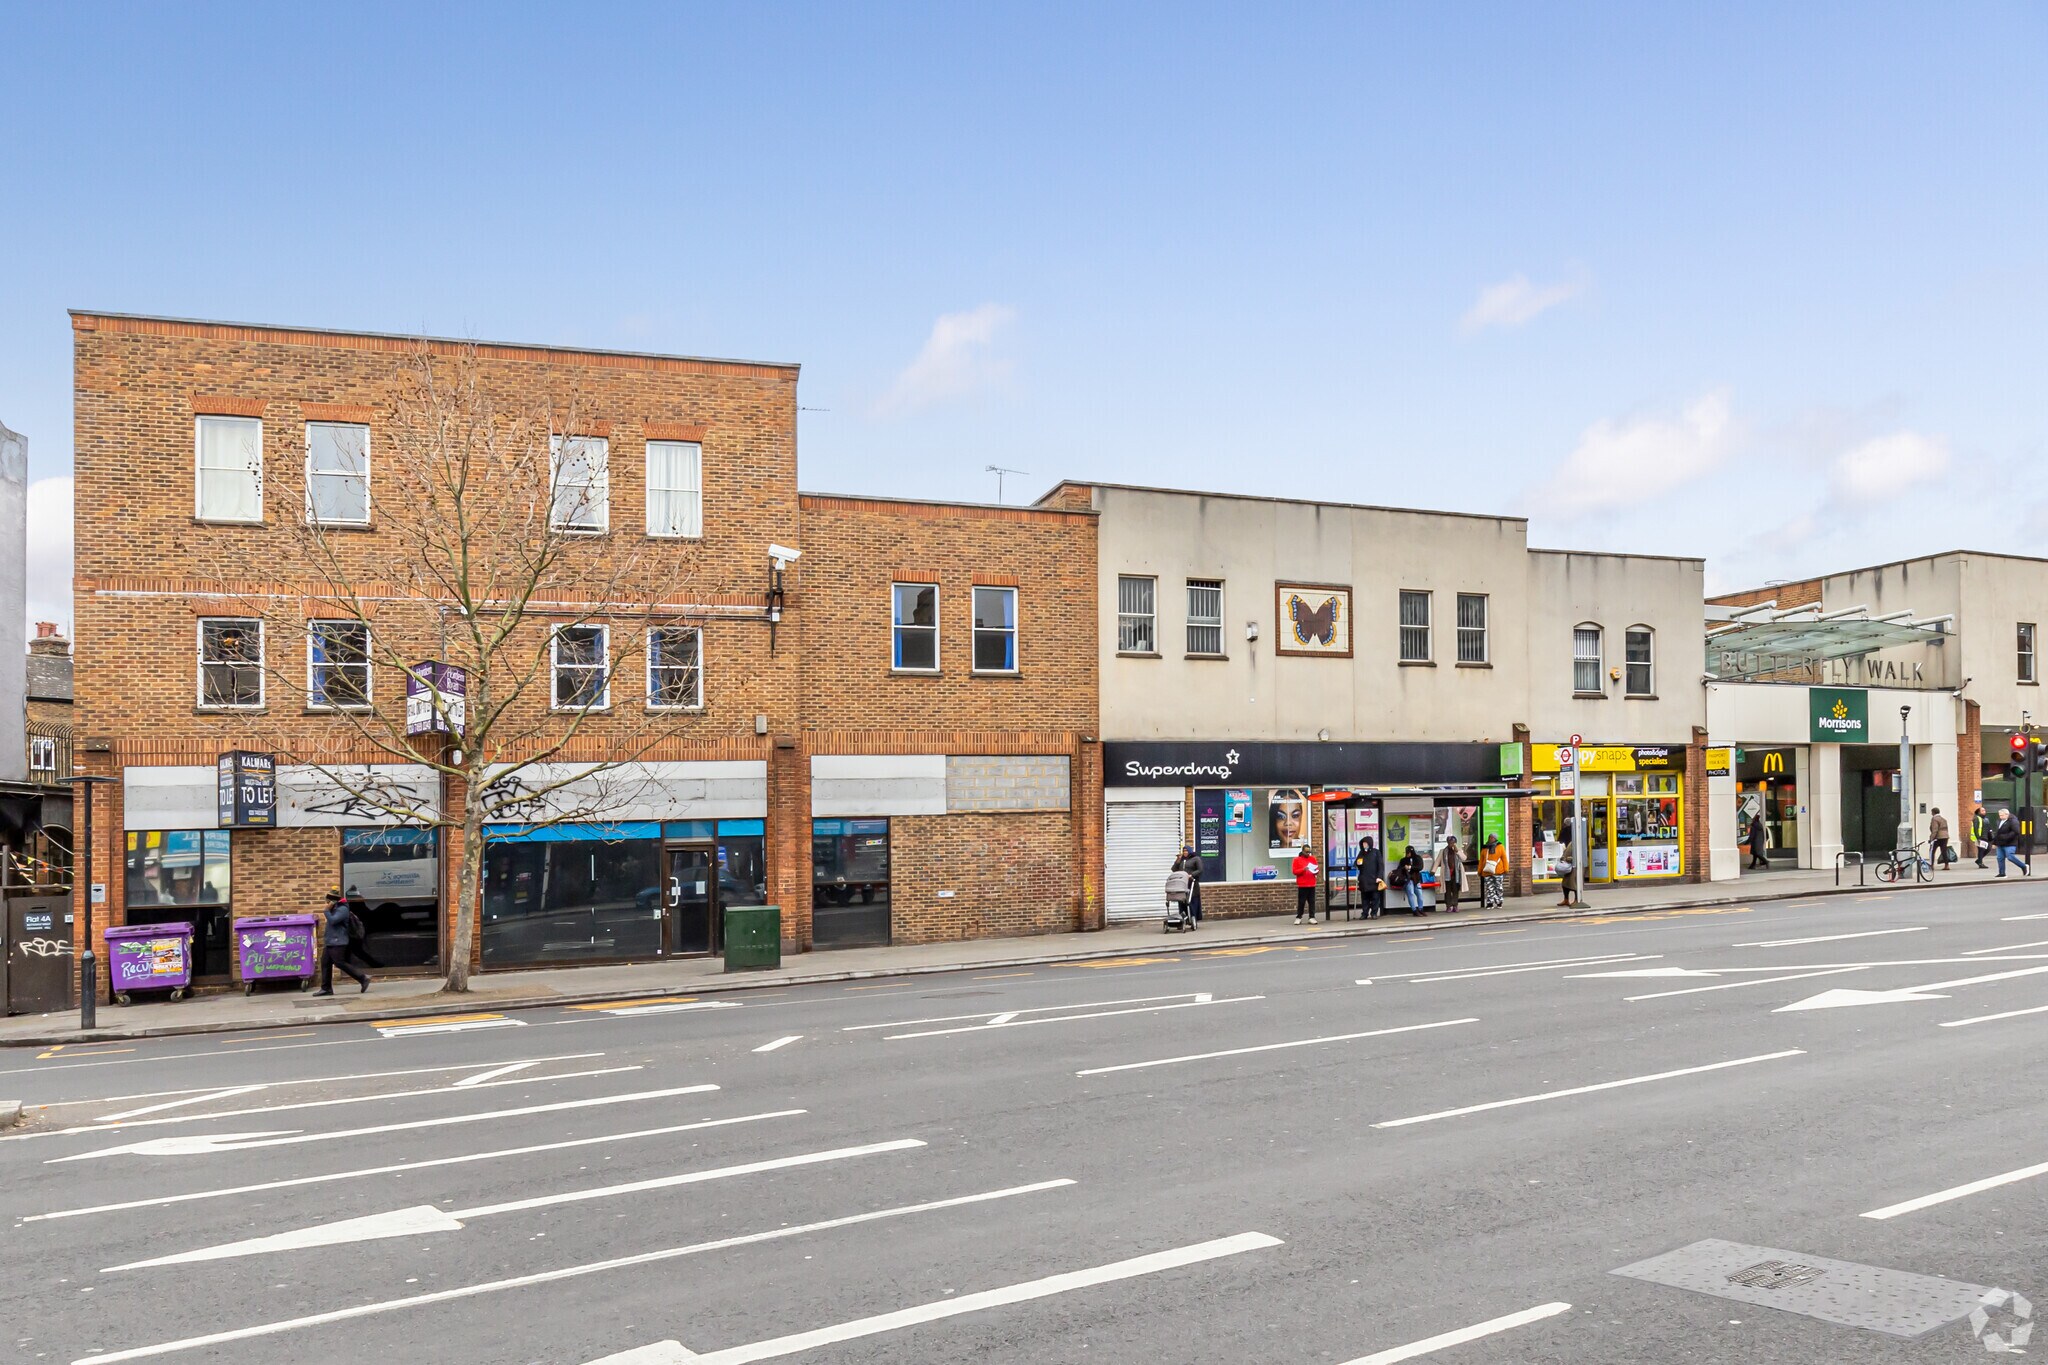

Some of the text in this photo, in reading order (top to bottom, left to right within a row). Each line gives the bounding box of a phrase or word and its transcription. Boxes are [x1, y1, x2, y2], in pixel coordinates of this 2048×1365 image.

[1867, 659, 1923, 681] WALK
[1819, 716, 1861, 729] Morrisons
[1572, 734, 1580, 745] P
[1597, 750, 1627, 764] snaps
[1638, 757, 1668, 766] specialists
[1125, 760, 1232, 779] Superdrug
[241, 787, 273, 804] TO LET
